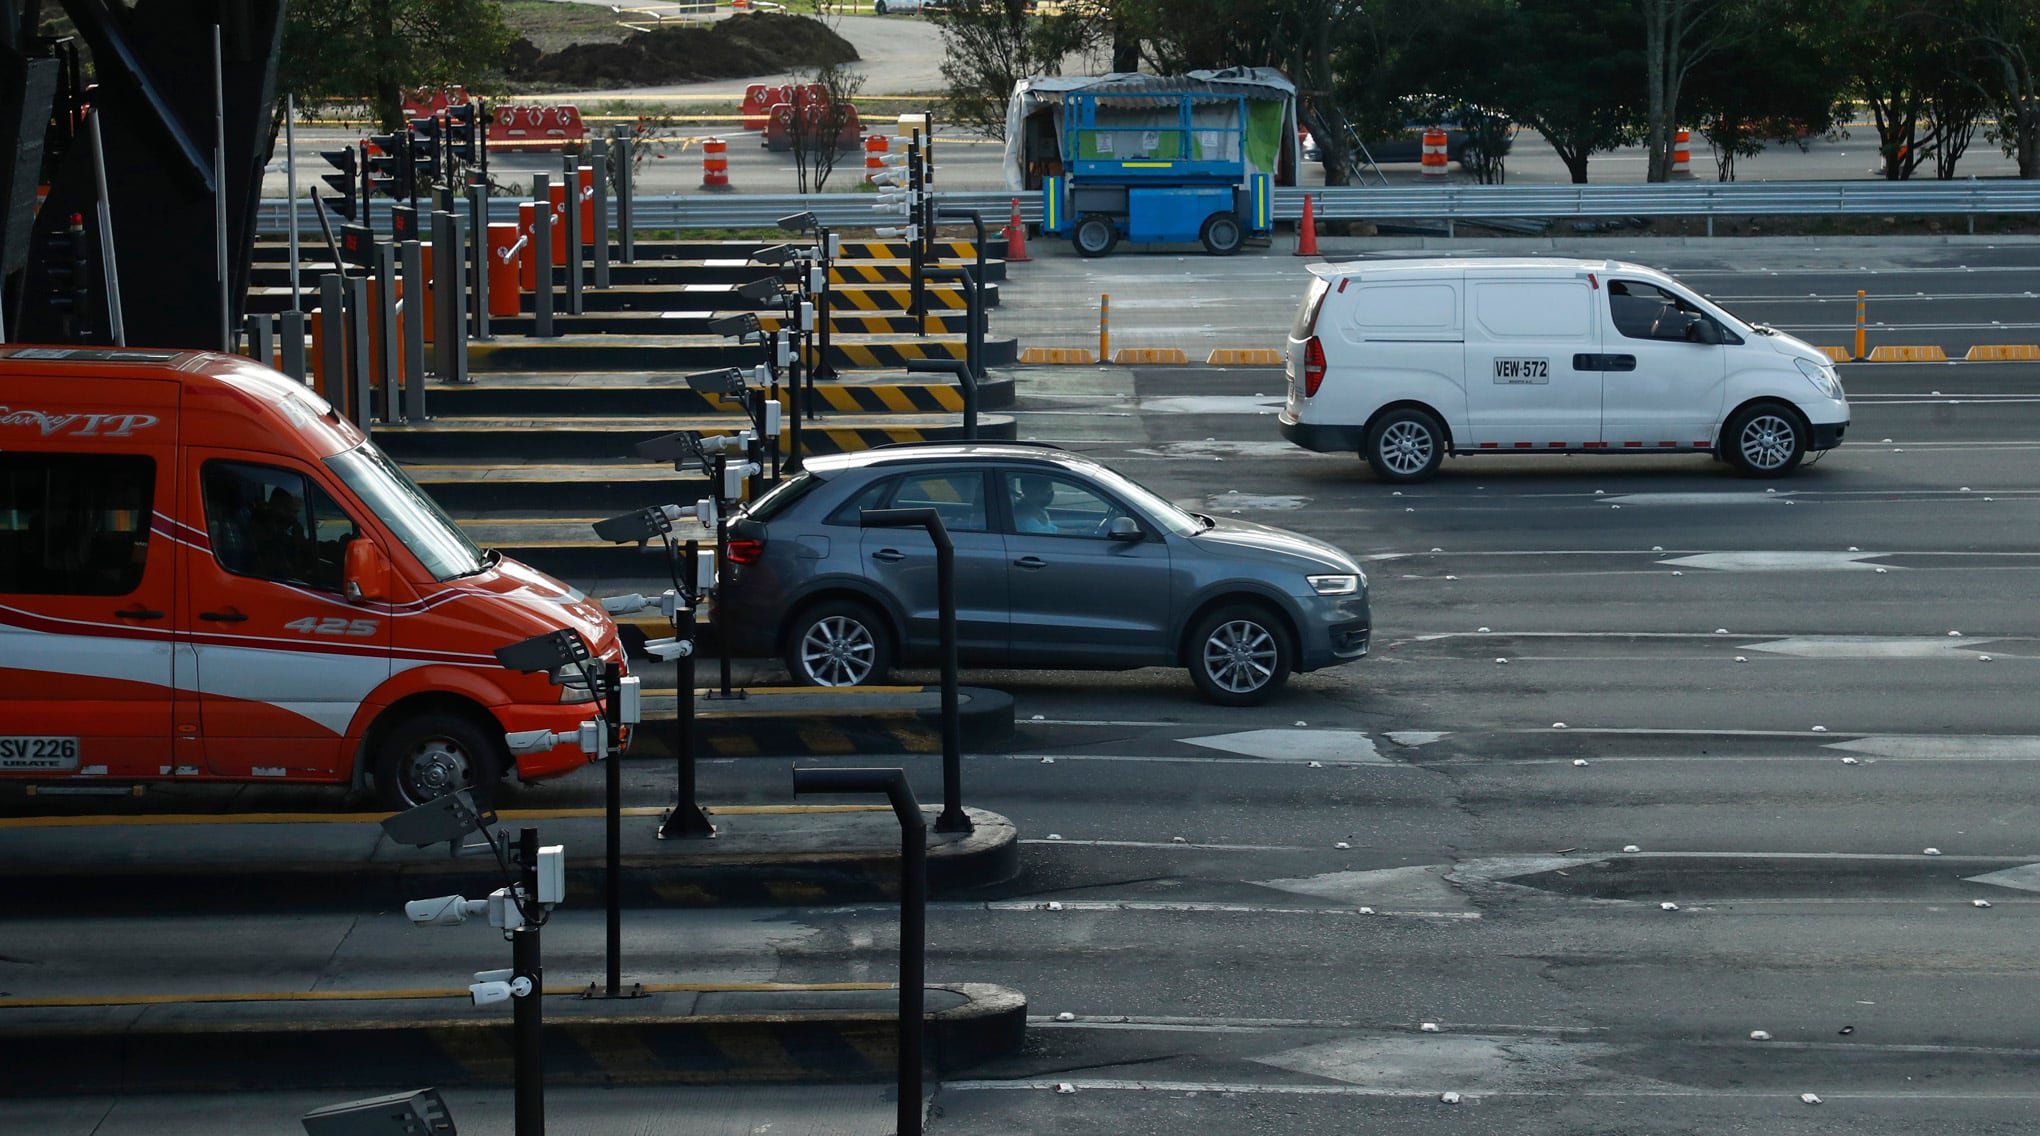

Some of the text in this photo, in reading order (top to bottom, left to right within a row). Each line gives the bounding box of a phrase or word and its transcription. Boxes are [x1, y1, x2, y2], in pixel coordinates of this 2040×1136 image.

[13, 410, 159, 436] VIP
[284, 617, 380, 636] 425
[32, 739, 75, 758] 226
